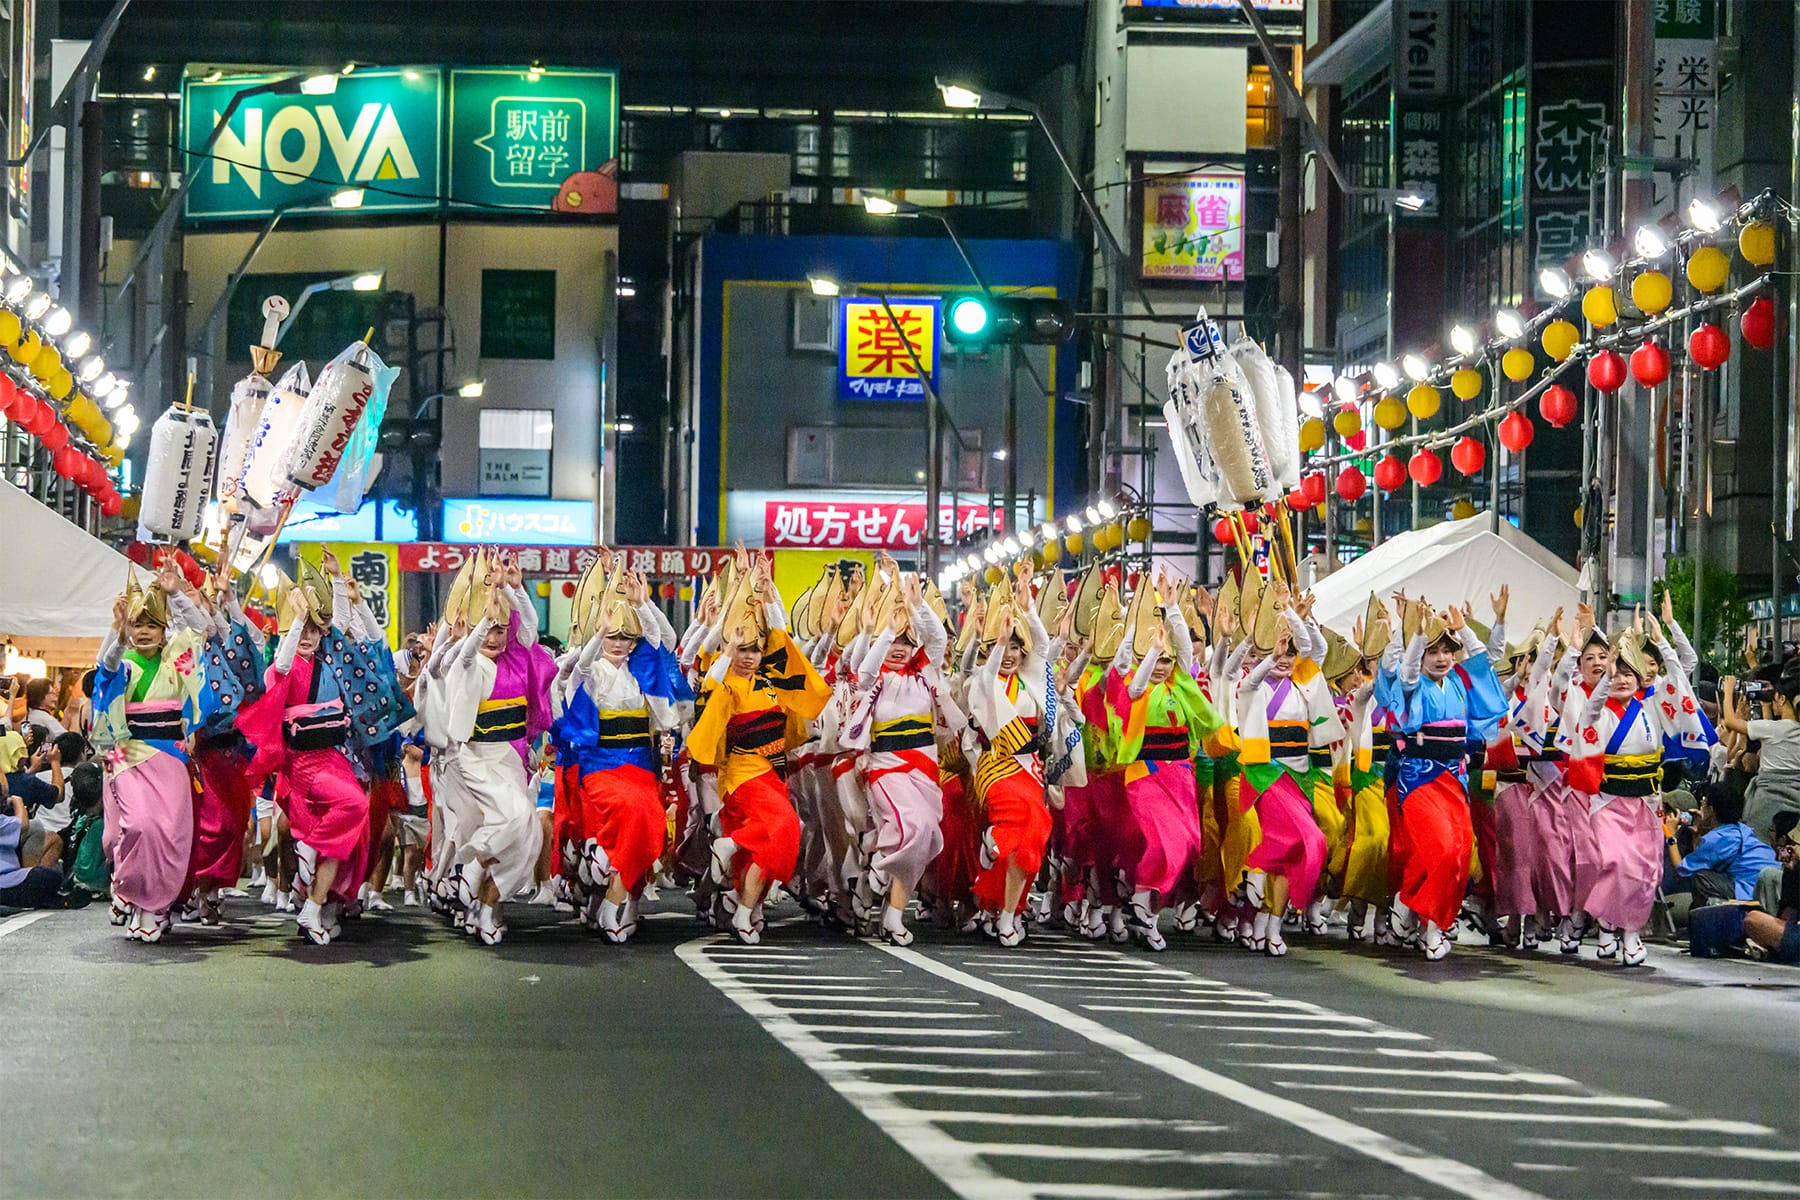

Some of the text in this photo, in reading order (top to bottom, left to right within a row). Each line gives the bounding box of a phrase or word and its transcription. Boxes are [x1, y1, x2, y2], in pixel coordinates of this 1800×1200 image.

[1408, 11, 1436, 90] iYell
[506, 109, 571, 142] 駅前
[1678, 56, 1710, 131] 栄光
[212, 102, 420, 199] NOVA
[506, 146, 570, 177] 留学
[858, 309, 923, 374] 薬
[488, 511, 577, 533] ハウスコム
